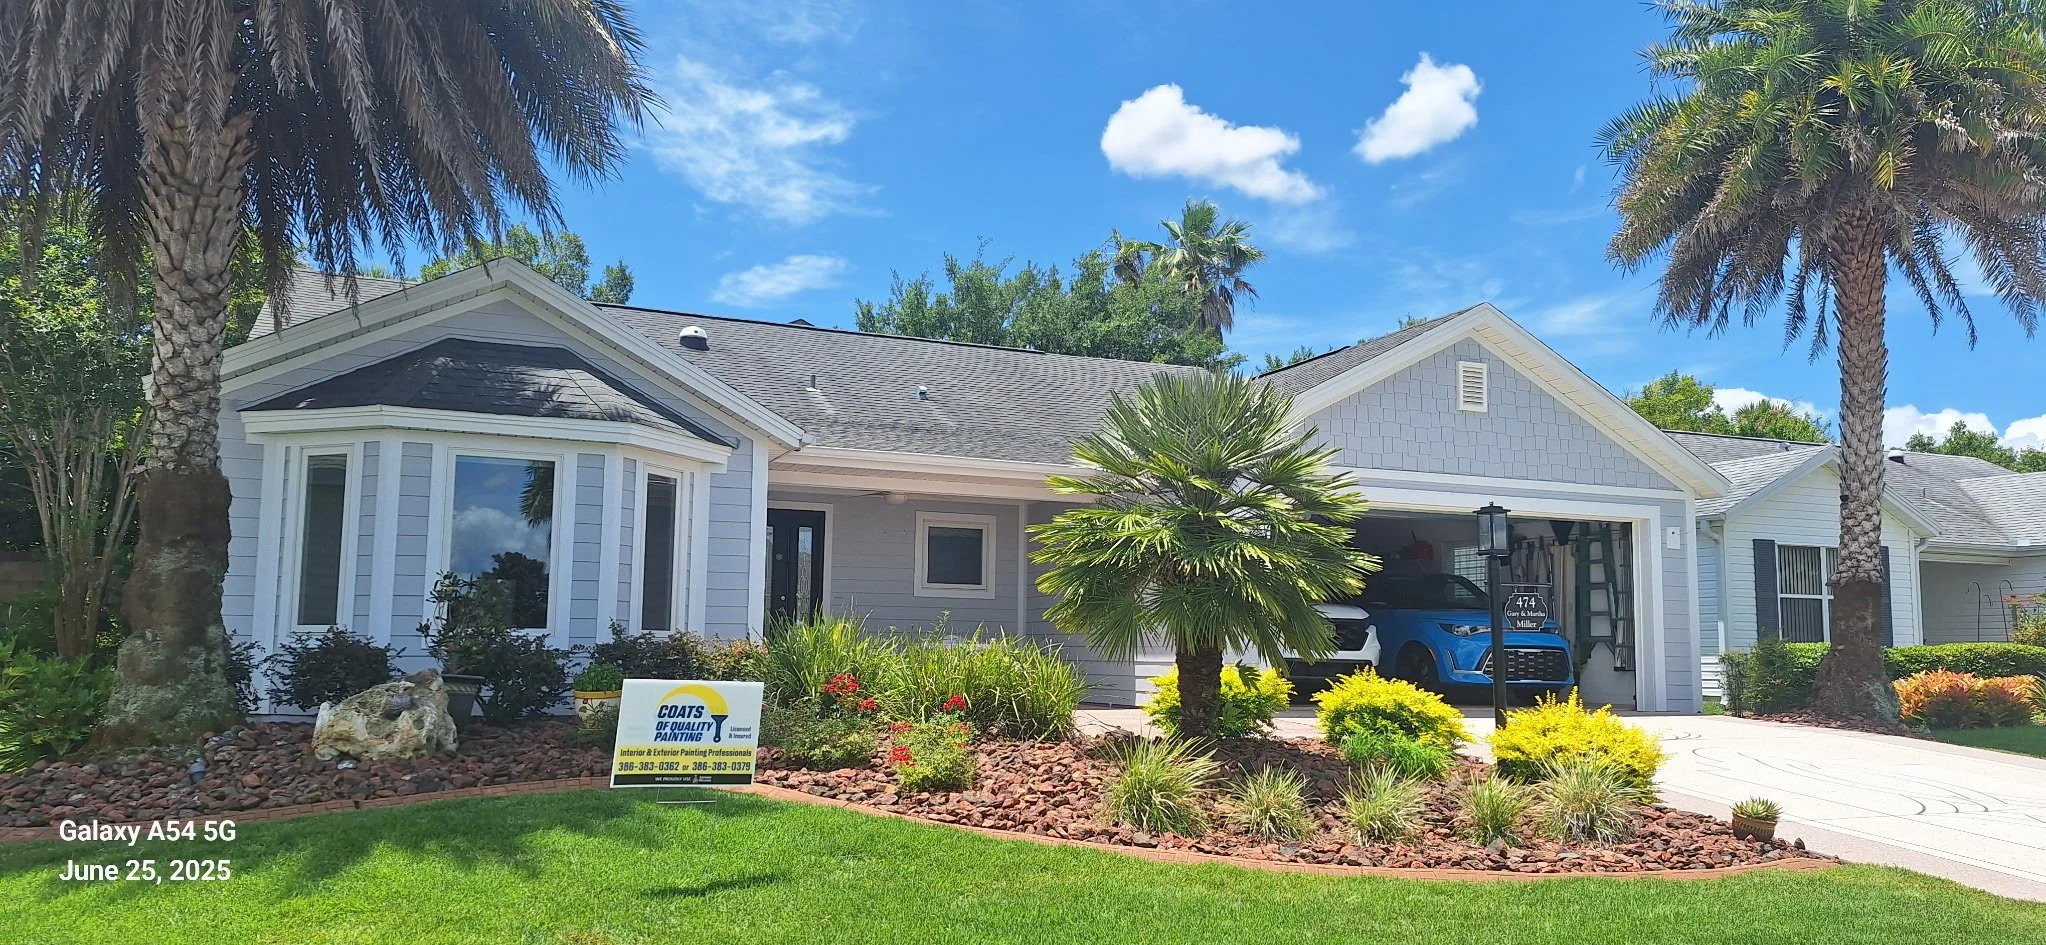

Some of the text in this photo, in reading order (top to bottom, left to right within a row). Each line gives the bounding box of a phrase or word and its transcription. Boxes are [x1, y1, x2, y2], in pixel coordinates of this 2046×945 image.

[1516, 597, 1536, 608] 474
[1507, 610, 1519, 618] Gary
[657, 705, 705, 719] COATS
[655, 721, 714, 733] OF QUALITY
[654, 731, 703, 742] PAINTING
[620, 748, 752, 758] Interior & Exterior Painting Professionals
[618, 762, 680, 772] 386-383-0362
[692, 762, 751, 771] 386-383-0379
